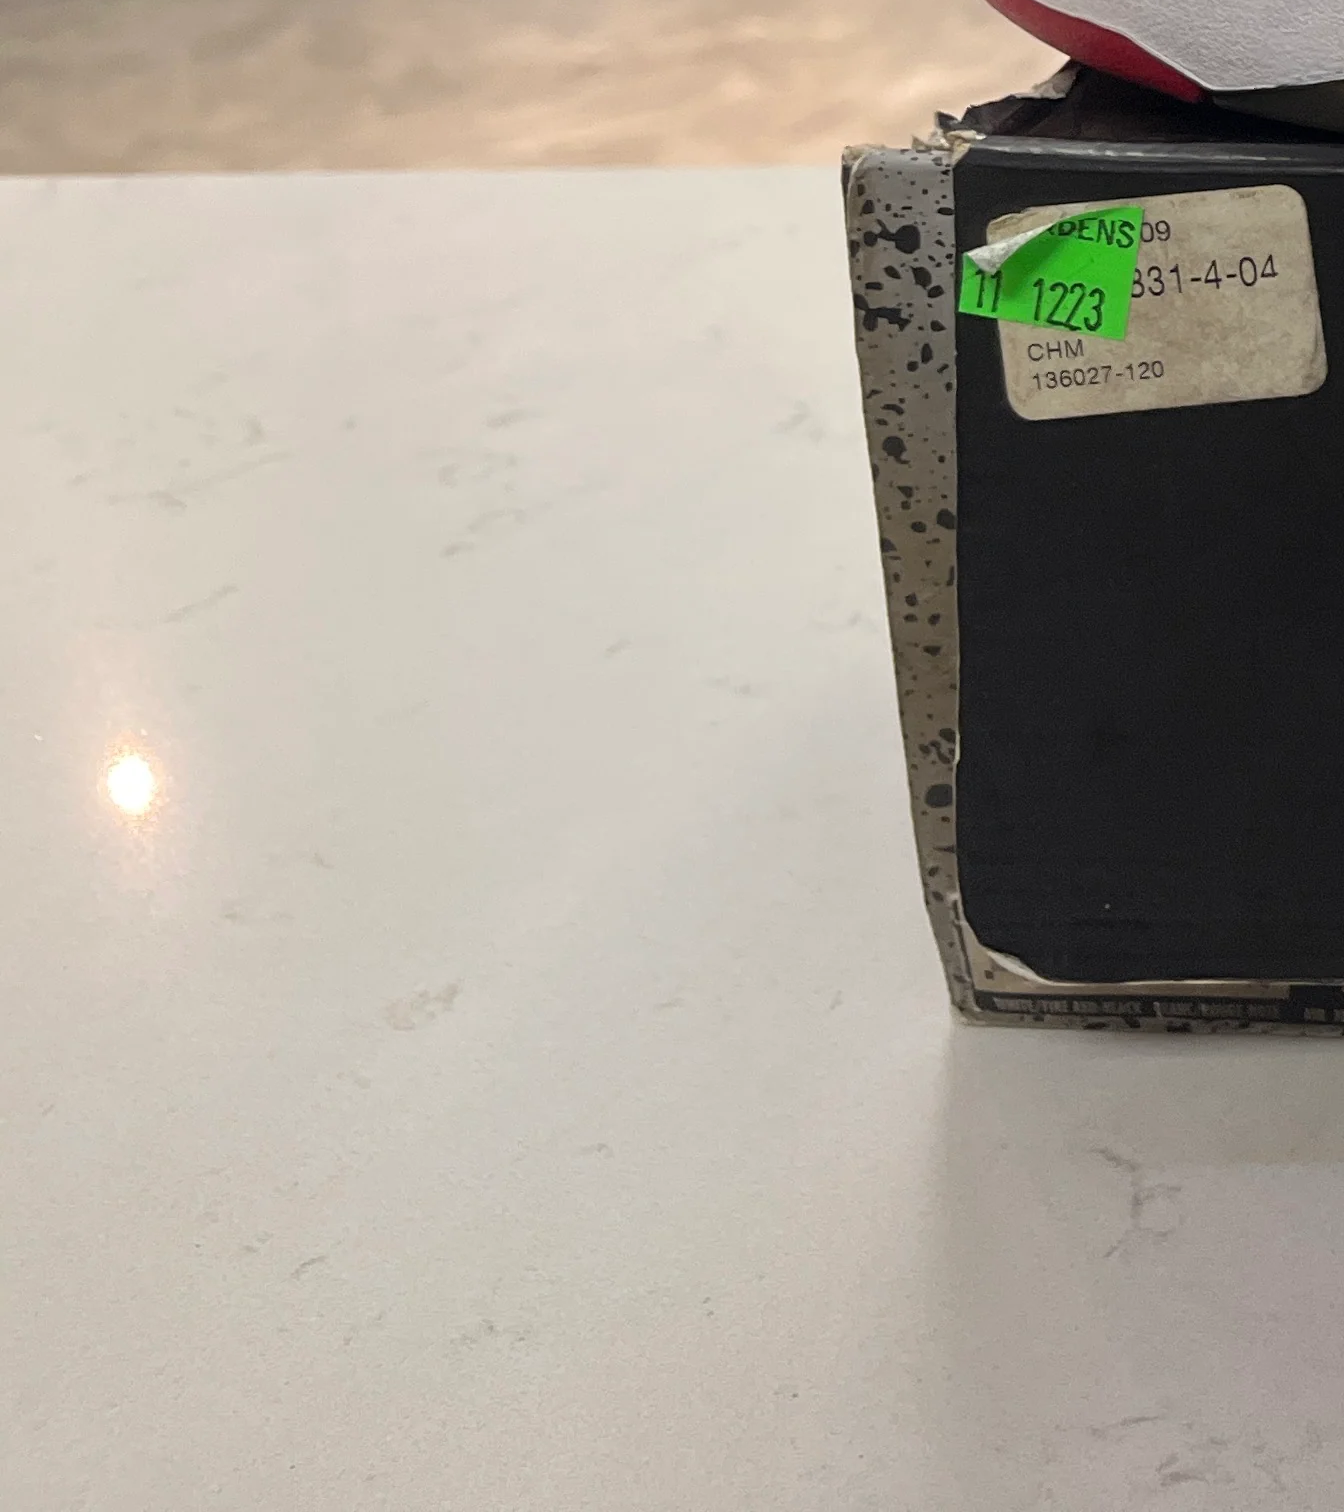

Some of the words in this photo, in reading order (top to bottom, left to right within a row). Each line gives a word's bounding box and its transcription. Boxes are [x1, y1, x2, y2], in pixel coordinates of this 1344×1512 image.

[1051, 217, 1135, 248] DENS
[1033, 278, 1106, 332] 1223
[1027, 339, 1084, 361] CHM
[1032, 360, 1164, 390] 136027-120
